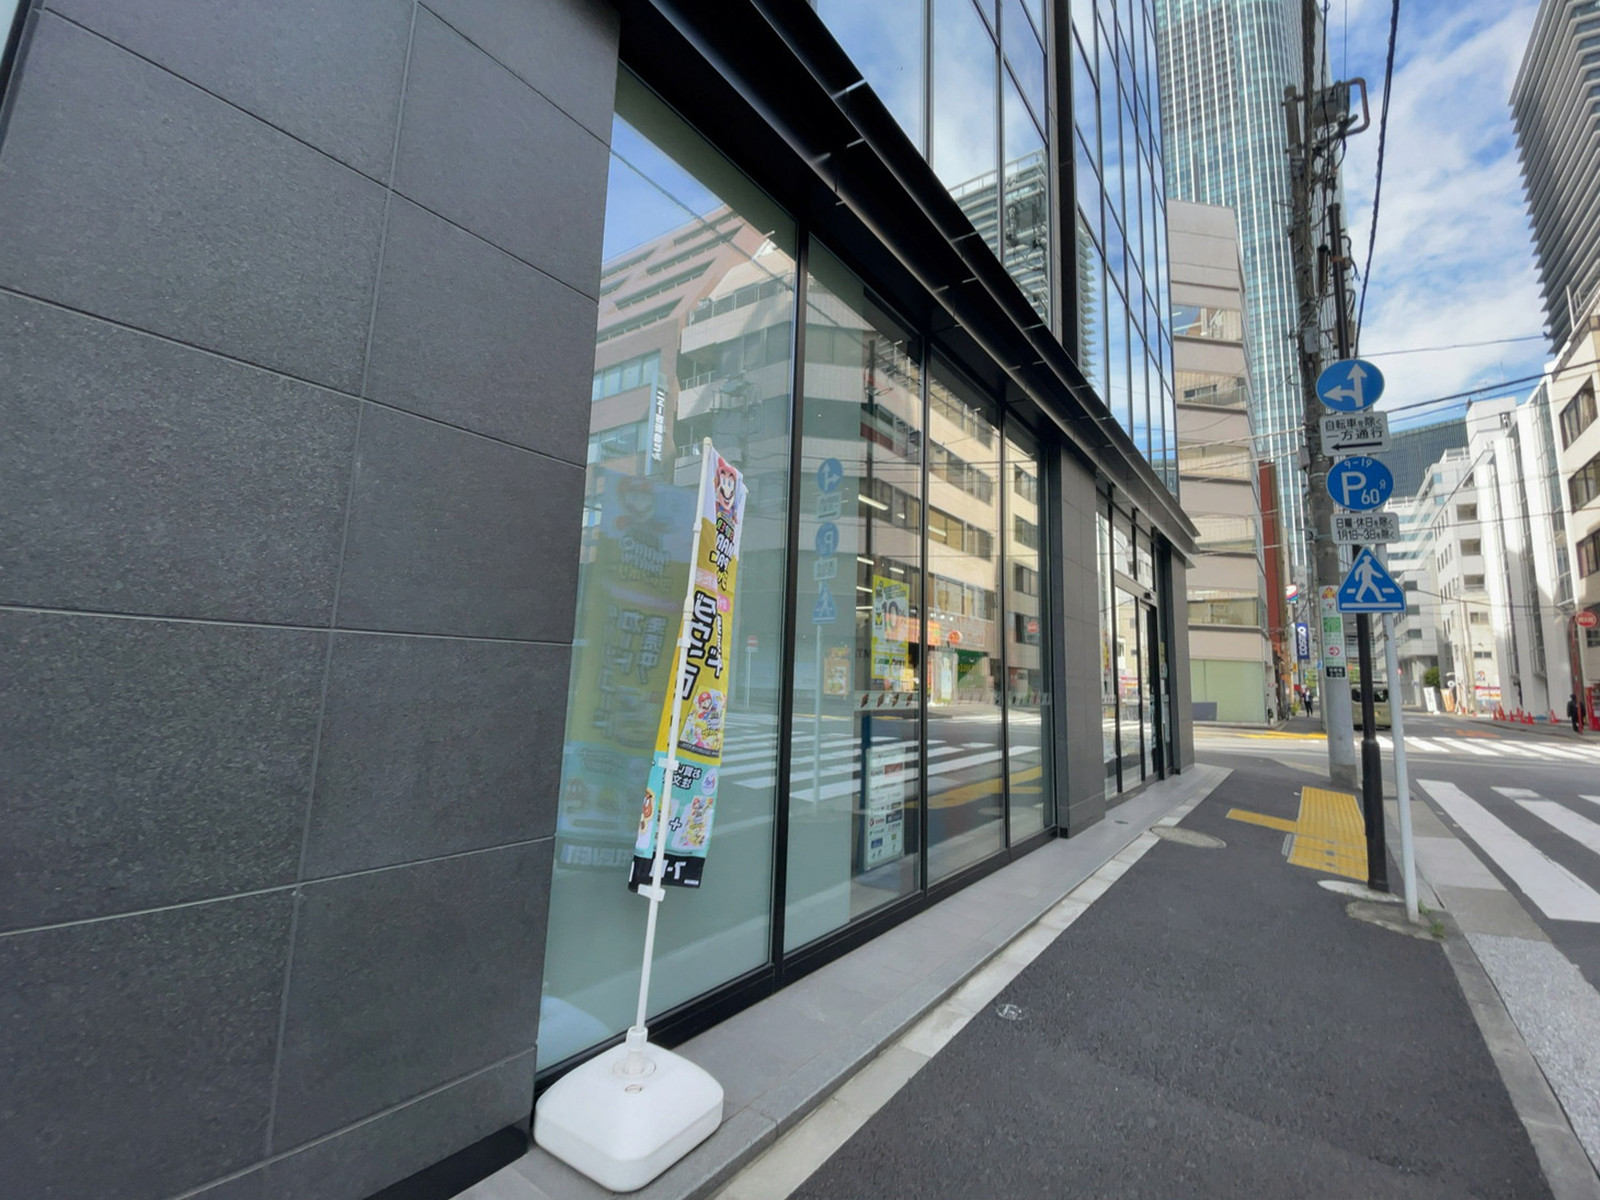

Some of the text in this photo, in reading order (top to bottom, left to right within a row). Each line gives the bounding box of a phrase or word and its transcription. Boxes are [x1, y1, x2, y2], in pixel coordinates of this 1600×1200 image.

[1325, 416, 1382, 431] 自転車を除く
[1326, 428, 1383, 441] 一方通行
[1344, 457, 1373, 469] 9-19
[1341, 471, 1367, 506] P
